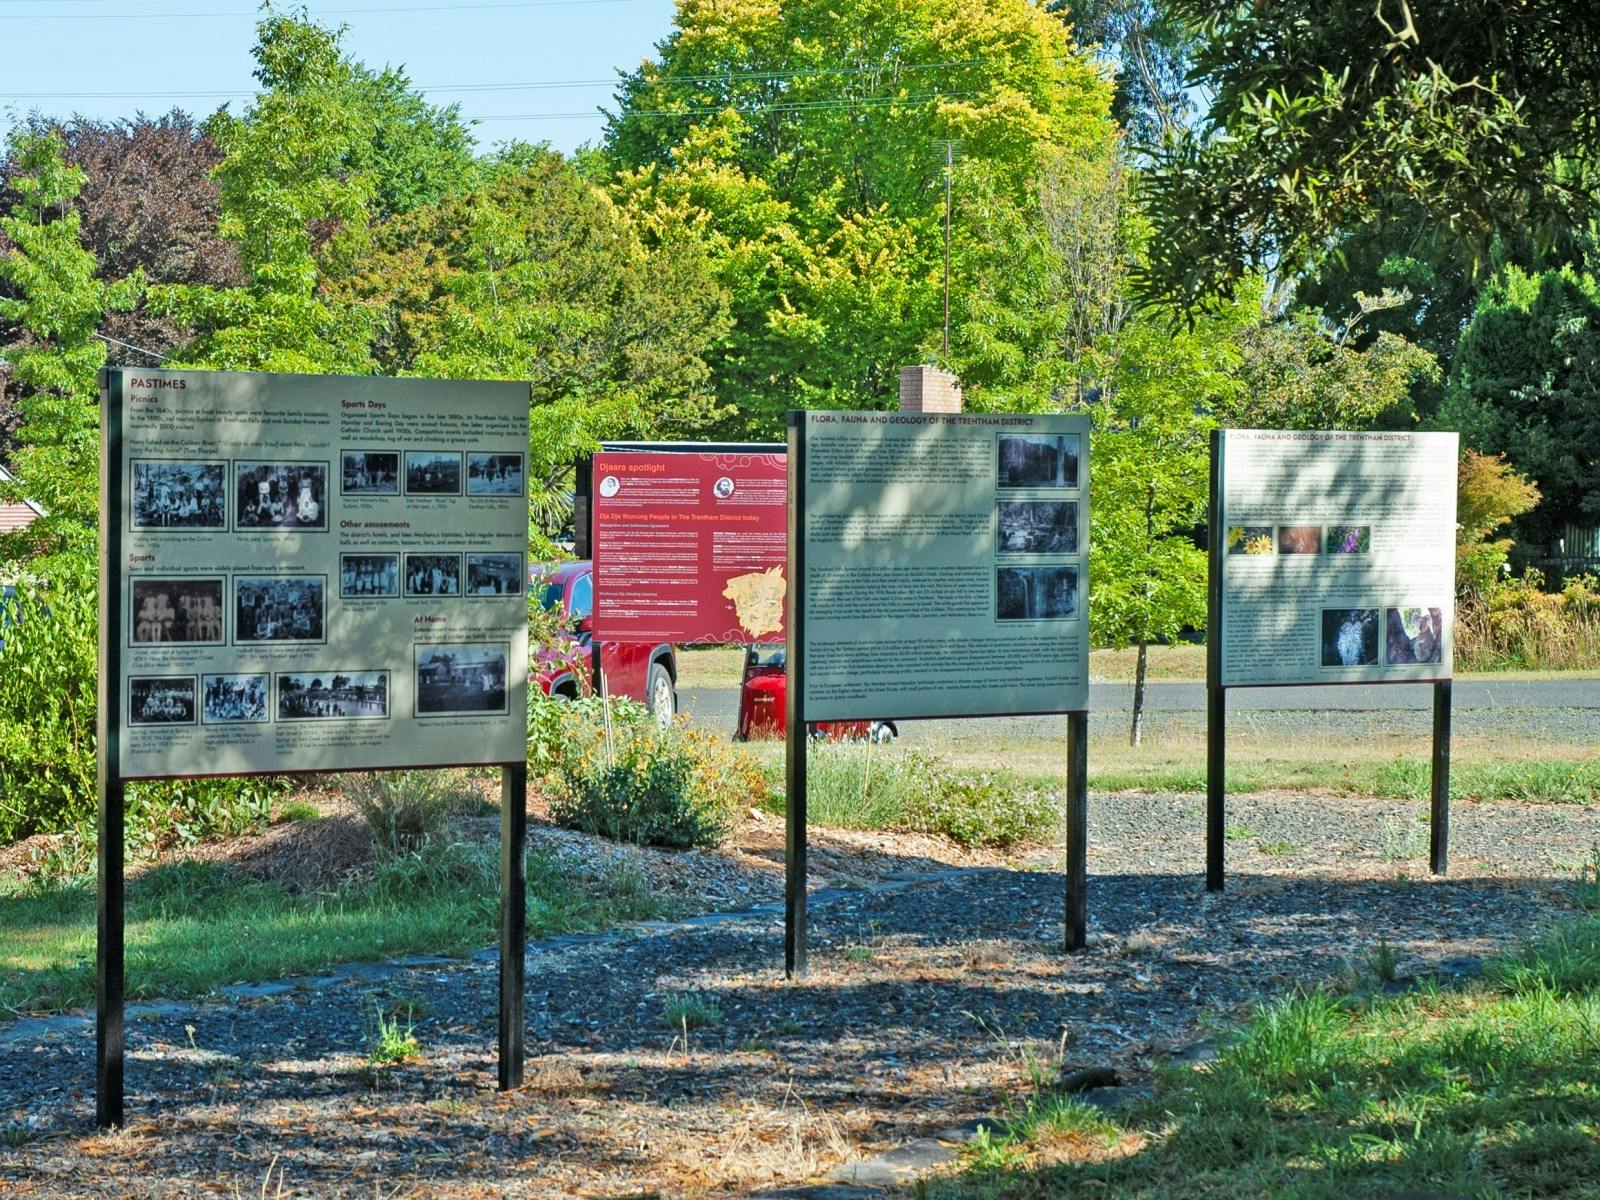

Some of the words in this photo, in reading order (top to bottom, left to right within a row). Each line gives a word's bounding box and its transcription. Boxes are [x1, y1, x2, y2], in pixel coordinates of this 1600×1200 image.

[130, 378, 186, 389] PASTIMES
[130, 395, 158, 403] Picnics
[341, 400, 366, 409] Sports
[368, 401, 386, 410] Days
[811, 415, 839, 424] FLORA,
[841, 415, 868, 425] FAUNA
[870, 416, 888, 425] AND
[889, 416, 928, 425] GEOLOGY
[929, 416, 941, 426] OF
[942, 416, 957, 426] THE
[958, 417, 999, 426] TRENTHAM
[1000, 417, 1034, 426] DISTRICT
[1348, 434, 1382, 442] TRENTHAM
[600, 464, 627, 473] Djaara
[628, 464, 666, 473] spotlight
[649, 514, 670, 522] People
[742, 514, 760, 522] today
[340, 520, 362, 529] Other
[364, 520, 410, 529] amusements
[129, 554, 156, 563] Sports
